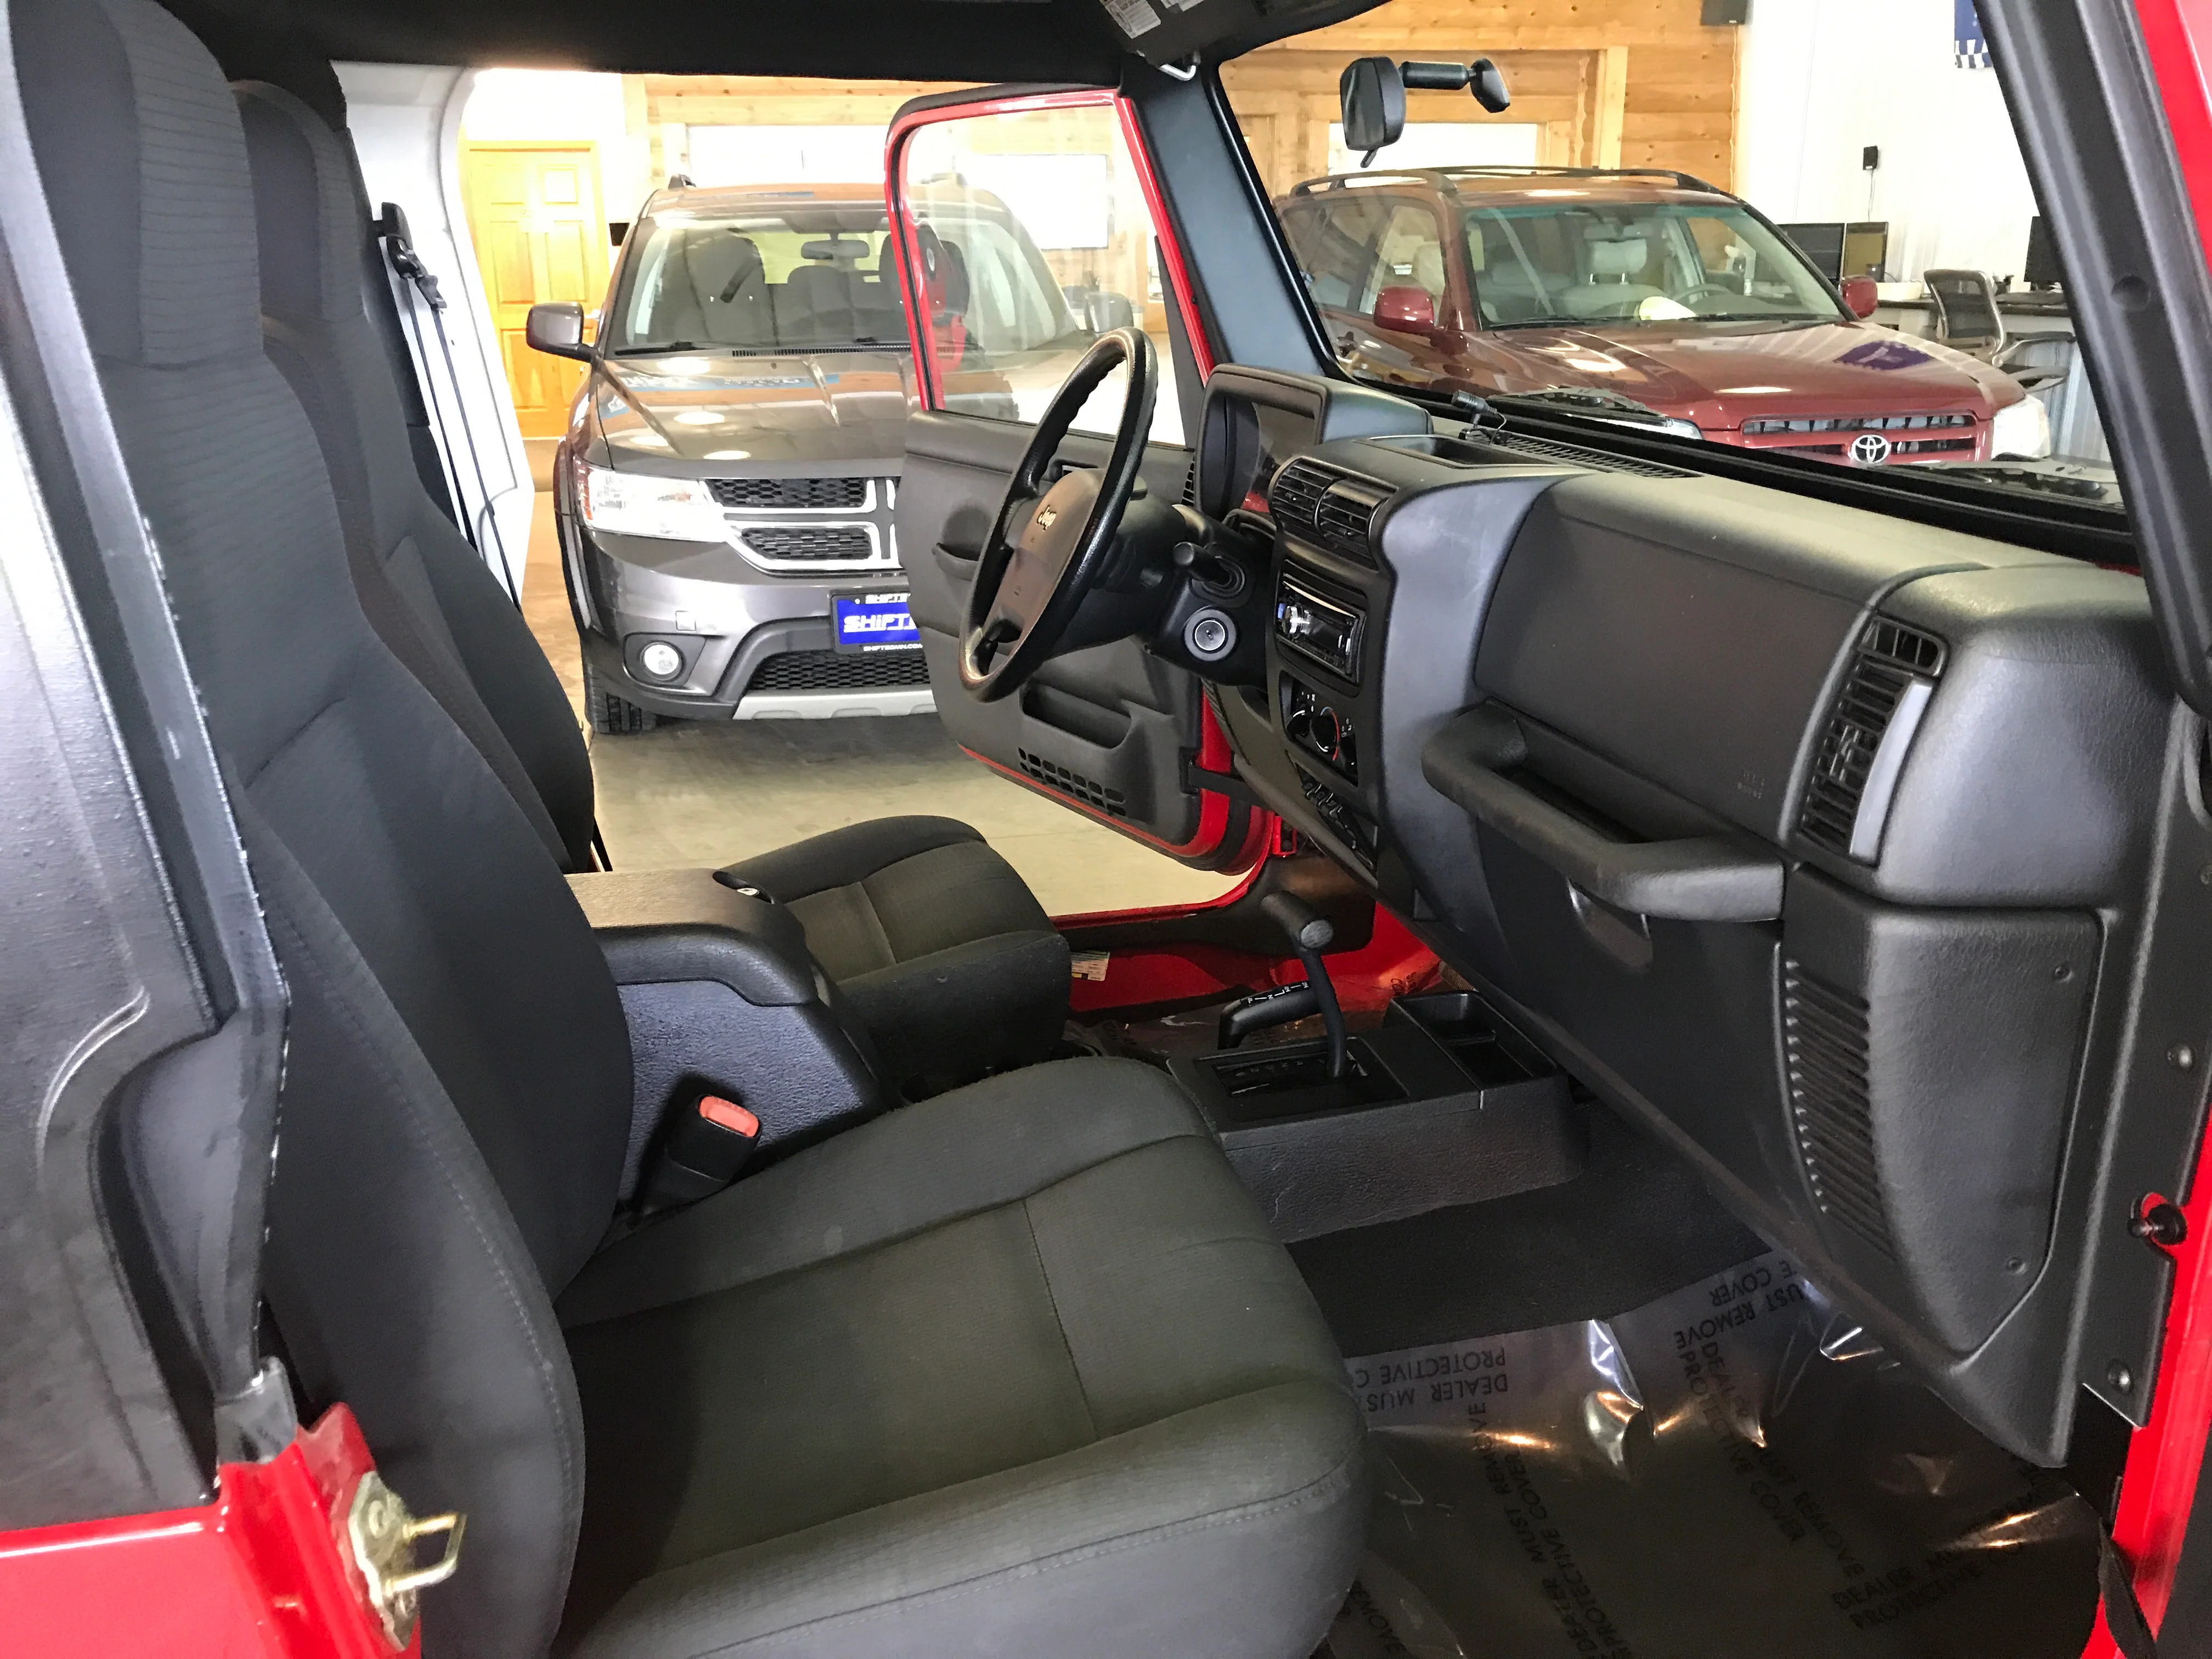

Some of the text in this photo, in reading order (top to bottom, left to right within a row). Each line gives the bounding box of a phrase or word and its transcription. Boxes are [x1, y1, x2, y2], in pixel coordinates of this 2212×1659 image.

[1674, 1283, 1805, 1350] UST REMOVE
[1709, 1268, 1771, 1307] COVER
[1363, 1373, 1509, 1413] DEALER MUS
[1380, 1347, 1506, 1385] PROTECTIVE
[1505, 1453, 1547, 1521] COVER
[1504, 1506, 1547, 1565] MUST
[1539, 1527, 1624, 1647] PROTECTIVE
